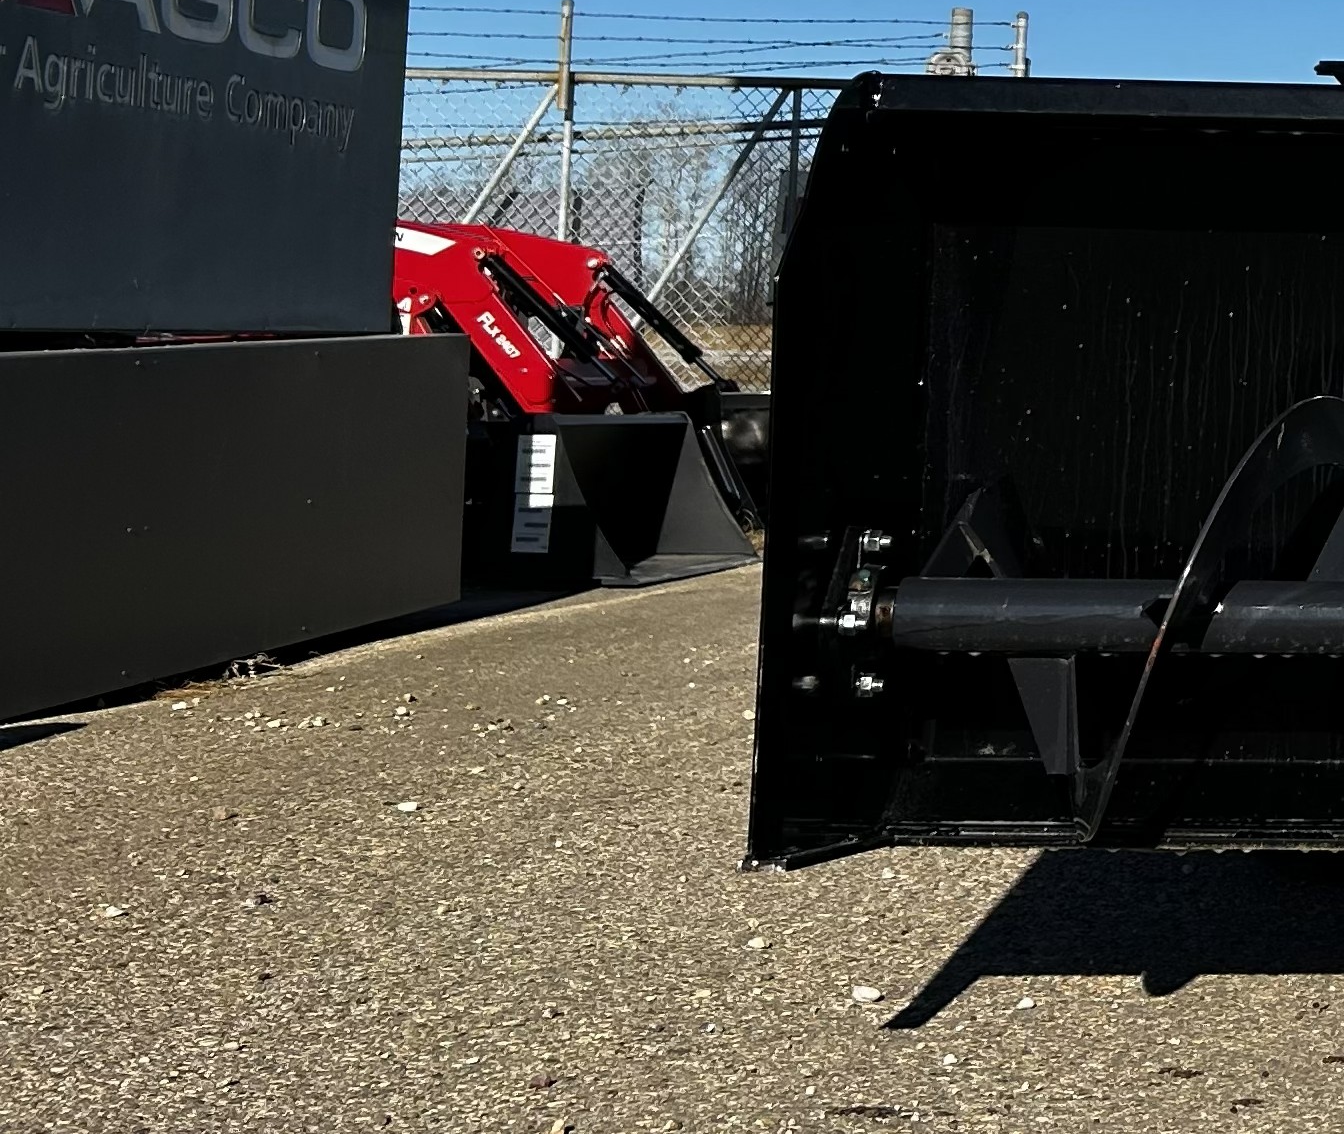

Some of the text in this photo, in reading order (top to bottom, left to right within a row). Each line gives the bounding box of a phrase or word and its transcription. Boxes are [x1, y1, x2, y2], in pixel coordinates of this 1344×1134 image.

[13, 36, 355, 152] Agriculture Company
[476, 311, 502, 338] FLX
